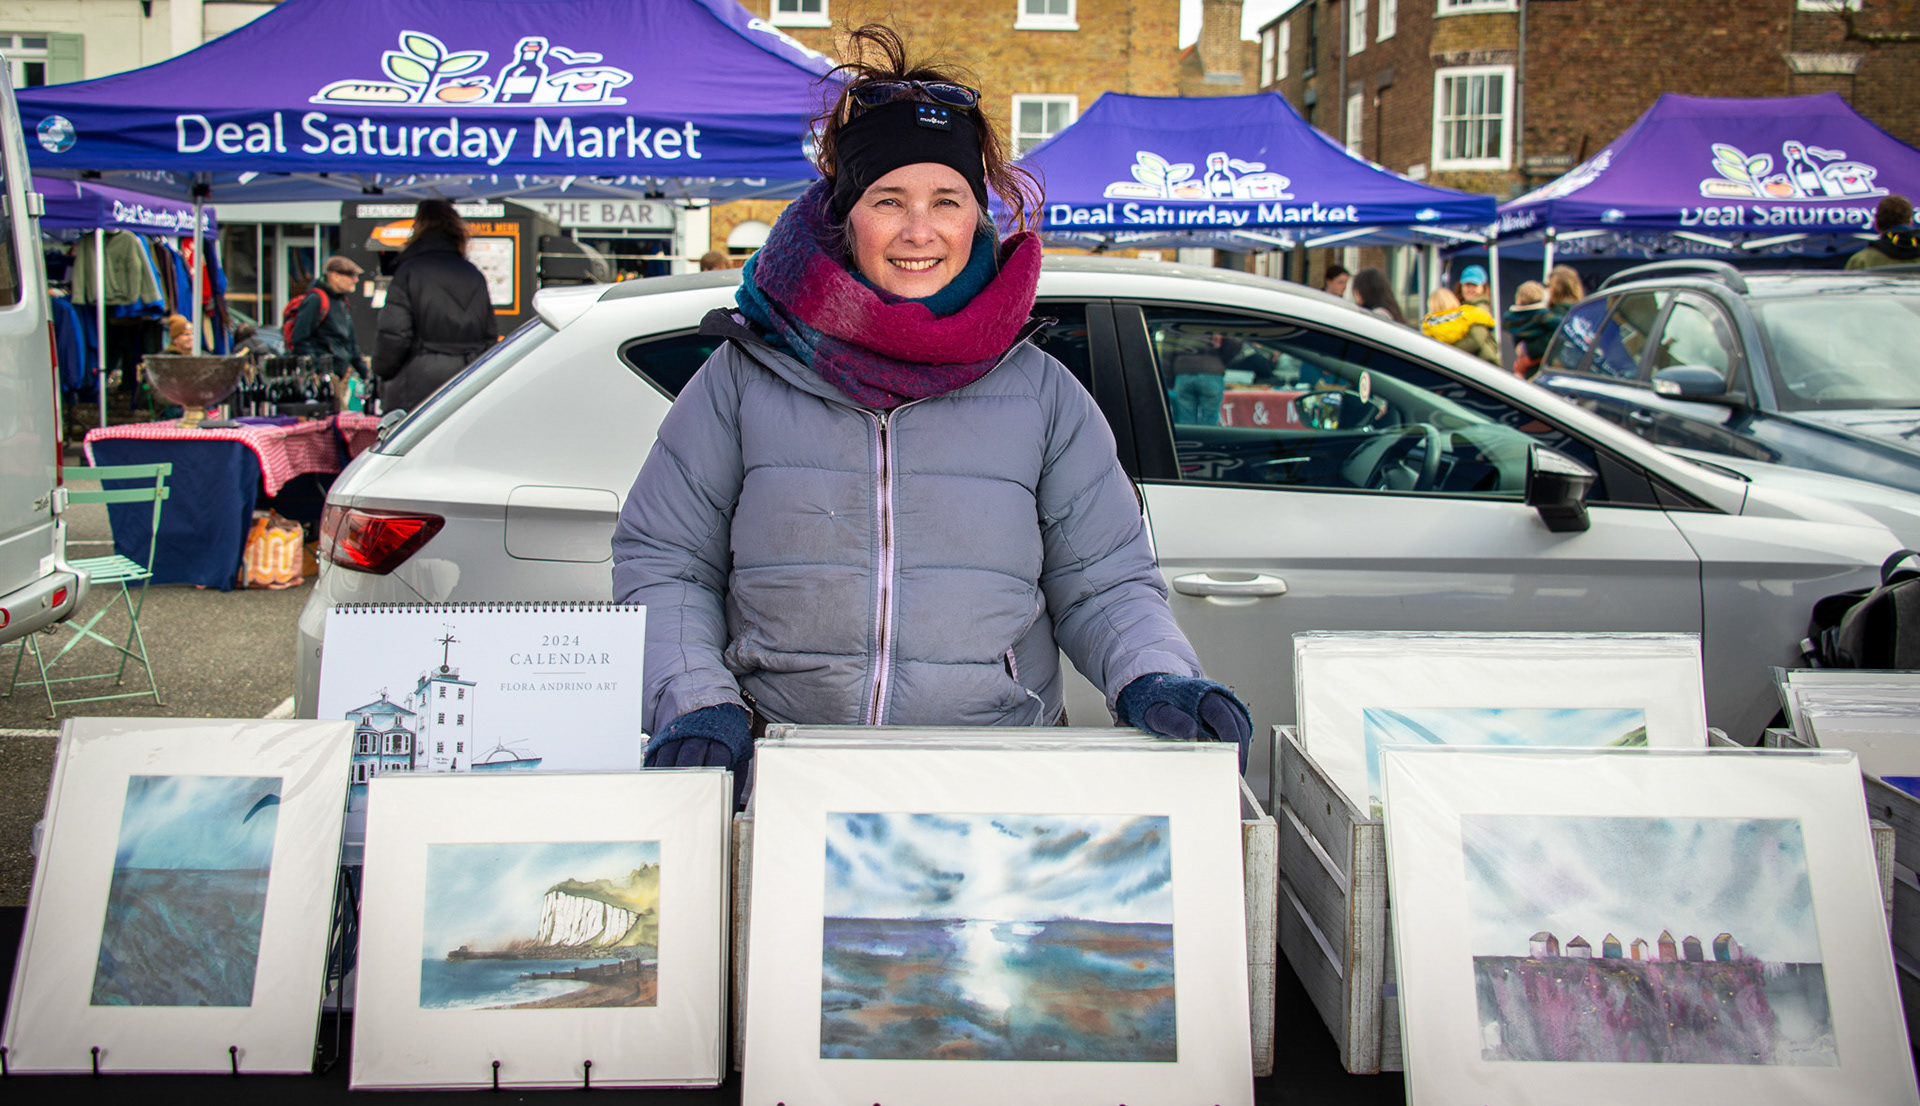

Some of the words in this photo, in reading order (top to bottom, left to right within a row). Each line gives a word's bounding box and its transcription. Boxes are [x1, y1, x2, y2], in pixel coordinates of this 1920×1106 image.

[175, 111, 287, 155] Deal
[301, 110, 518, 167] Saturday
[532, 115, 702, 160] Market
[112, 199, 137, 224] Deal
[136, 204, 179, 233] Saturday
[544, 203, 590, 223] THE
[601, 203, 653, 223] BAR
[1050, 202, 1115, 226] Deal
[1122, 202, 1250, 227] Saturday
[1257, 201, 1360, 223] Market
[1680, 205, 1745, 227] Deal
[1252, 400, 1269, 425] &
[542, 634, 579, 647] 2024
[509, 652, 611, 666] CALENDAR
[499, 682, 536, 692] FLORA
[539, 682, 593, 692] ANDRINO
[596, 682, 618, 691] ART
